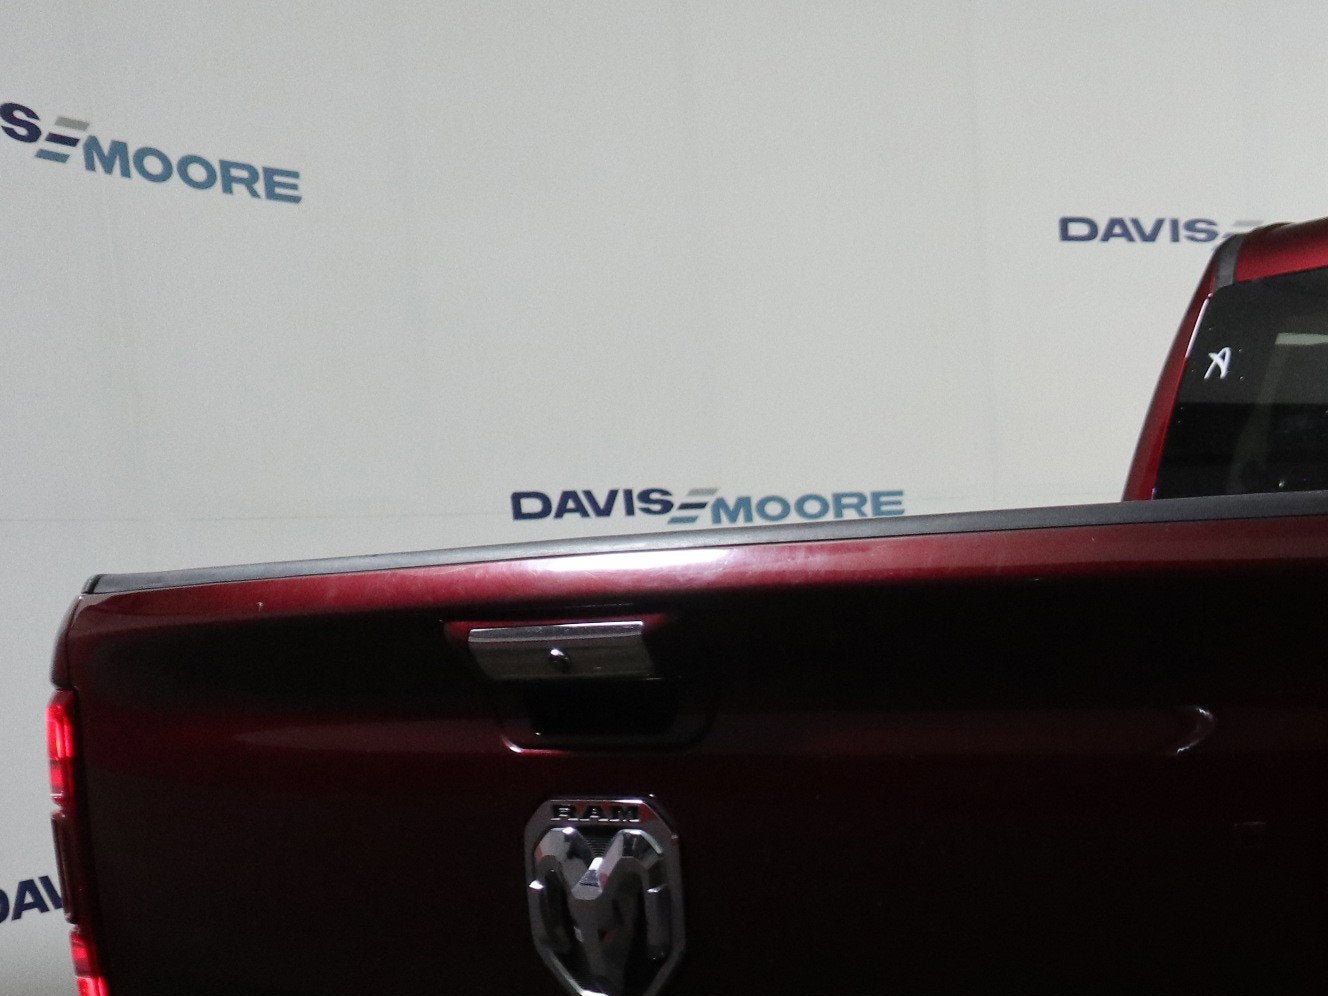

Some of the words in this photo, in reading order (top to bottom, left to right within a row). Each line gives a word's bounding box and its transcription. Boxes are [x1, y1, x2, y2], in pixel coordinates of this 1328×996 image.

[82, 134, 302, 204] MOORE
[1058, 216, 1220, 243] DAVIS
[510, 488, 674, 520] DAVIS
[711, 490, 905, 524] MOORE
[551, 804, 641, 824] RAM
[0, 875, 65, 923] AV
